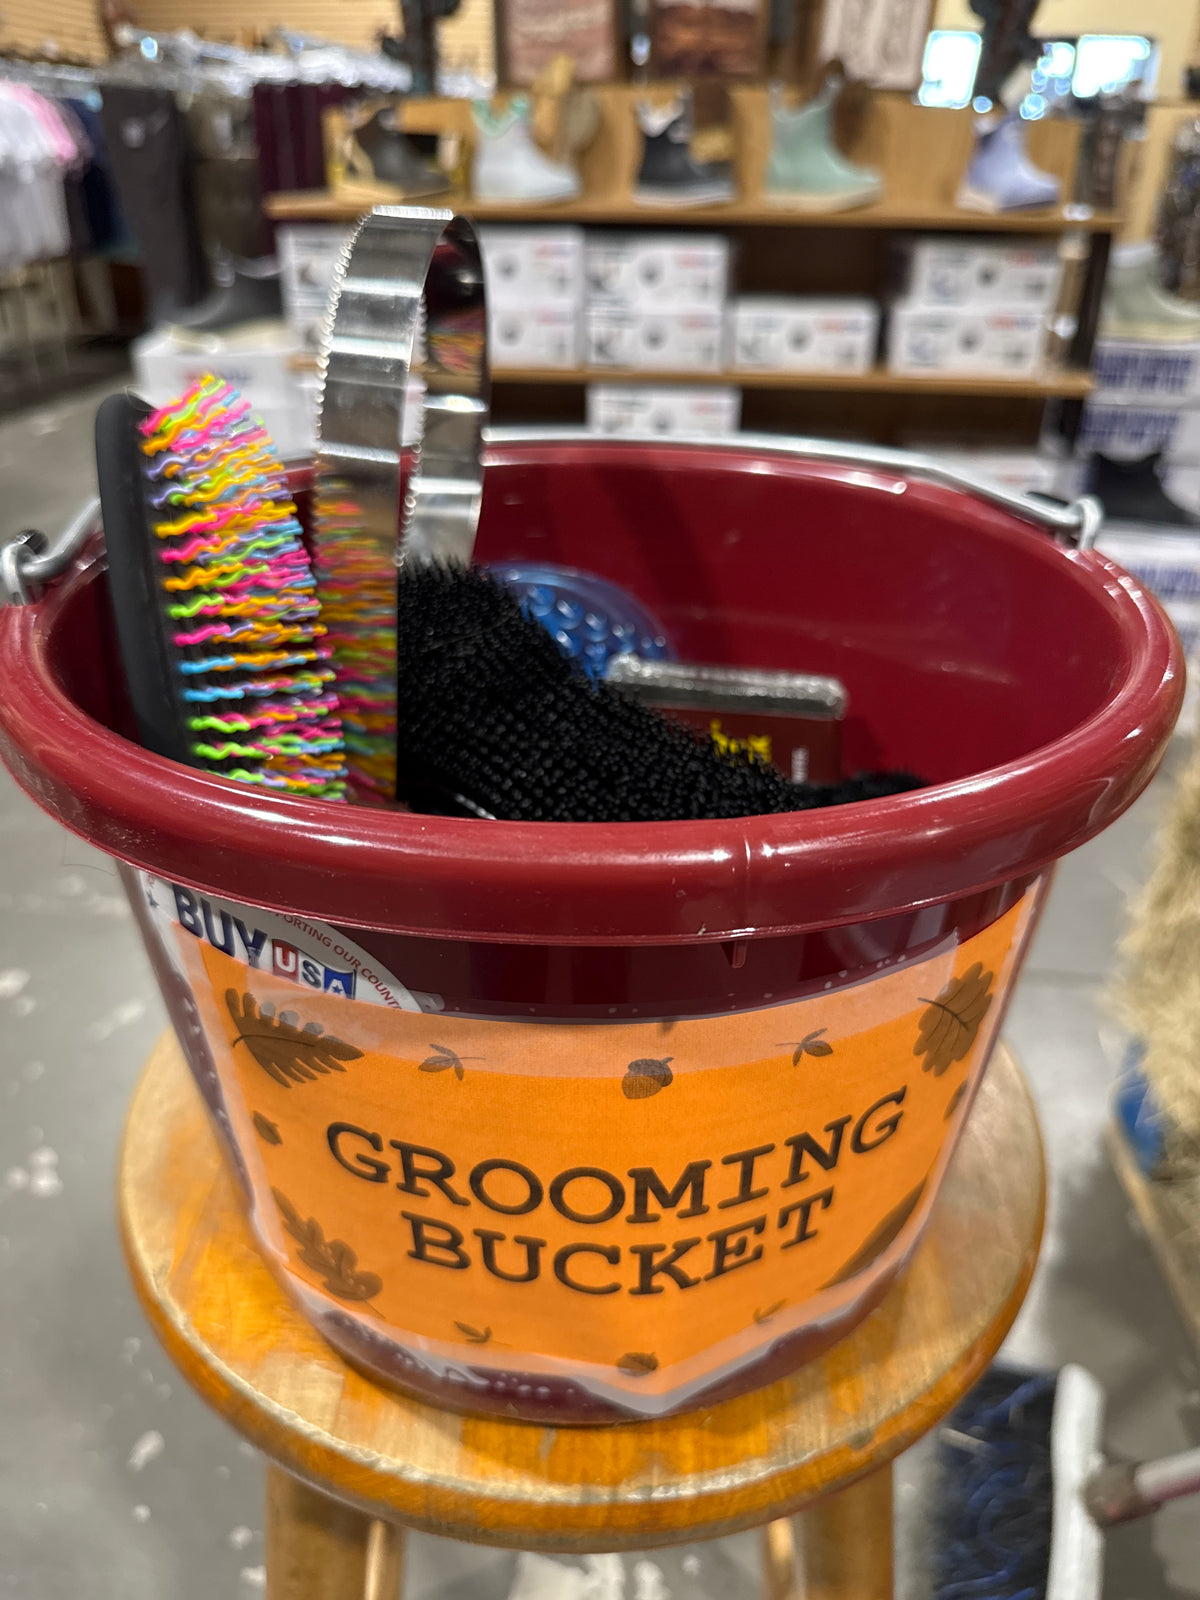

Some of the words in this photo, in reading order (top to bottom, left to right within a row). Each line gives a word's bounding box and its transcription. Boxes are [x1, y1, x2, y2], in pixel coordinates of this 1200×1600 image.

[172, 883, 268, 969] BUY
[274, 945, 347, 999] USA
[275, 914, 333, 947] ORTING
[333, 944, 361, 970] OUR
[326, 1086, 907, 1225] GROOMING
[400, 1186, 835, 1295] BUCKET
